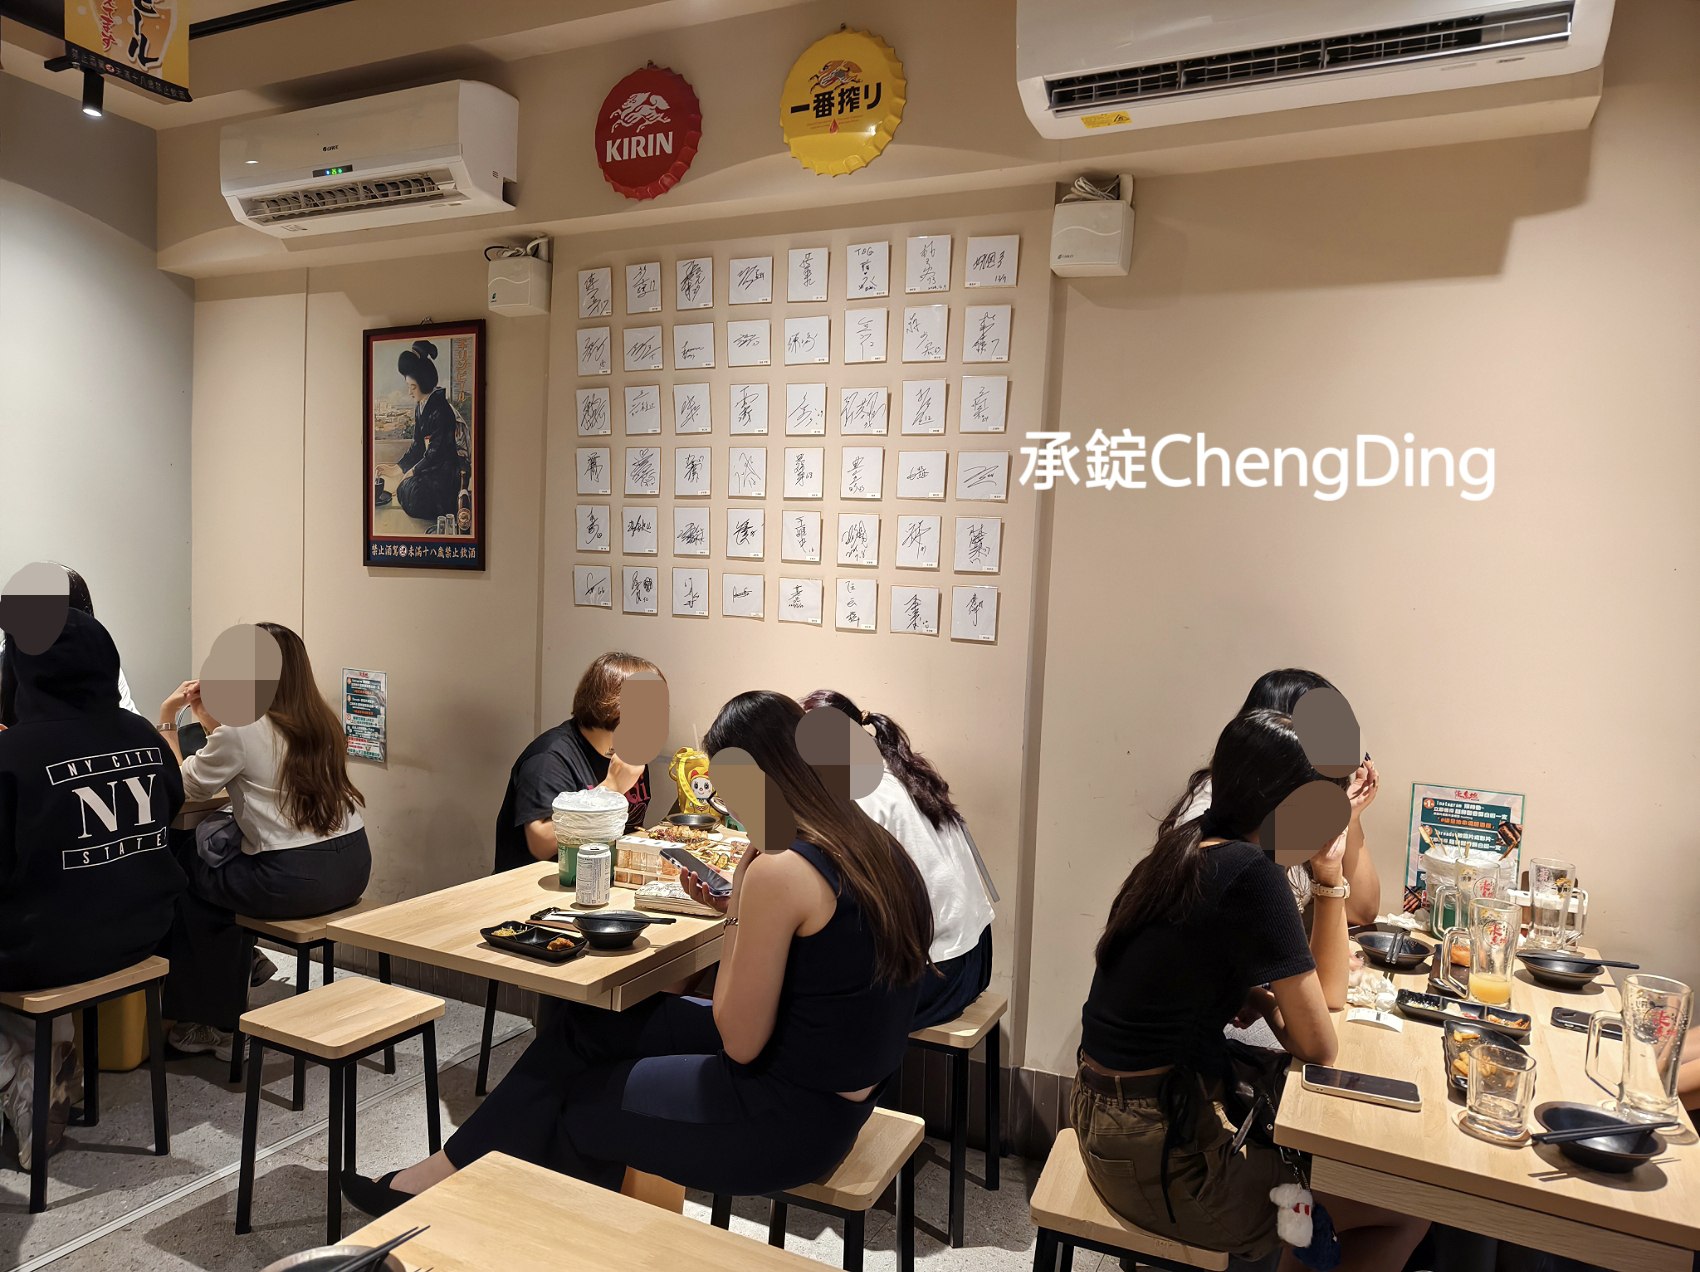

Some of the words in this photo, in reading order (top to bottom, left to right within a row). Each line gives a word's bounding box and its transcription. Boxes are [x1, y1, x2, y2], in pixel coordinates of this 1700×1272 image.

[789, 81, 882, 119] 一番搾り
[605, 131, 673, 163] KIRIN
[371, 544, 399, 557] 禁止酒駕
[67, 759, 93, 777] NY
[111, 750, 154, 768] CITY
[71, 773, 156, 839] NY
[1436, 800, 1463, 808] Instagram
[82, 833, 162, 864] STATE
